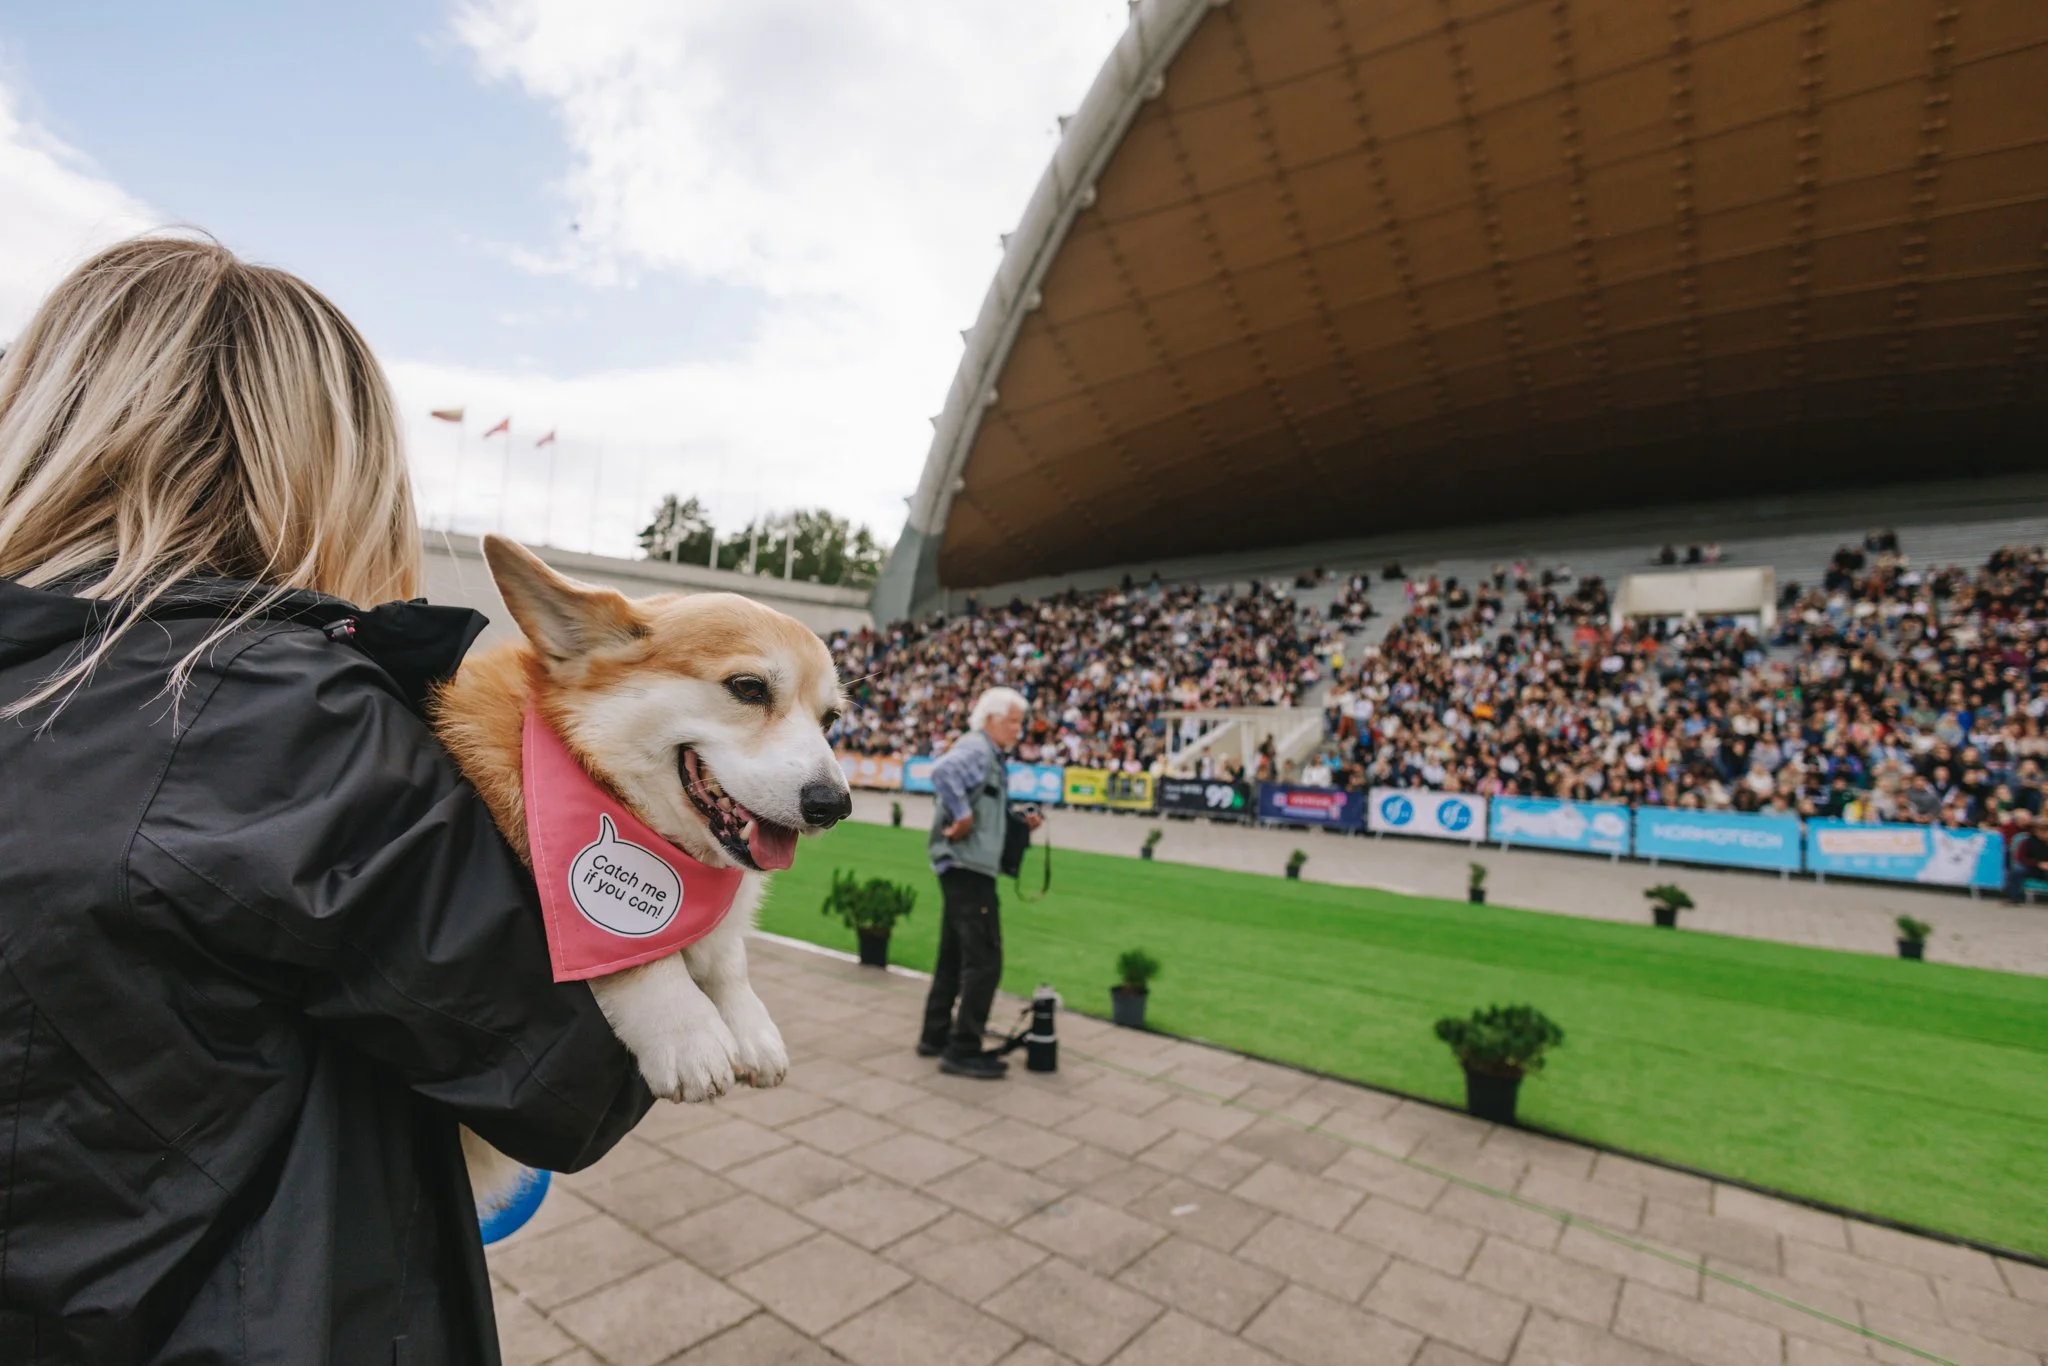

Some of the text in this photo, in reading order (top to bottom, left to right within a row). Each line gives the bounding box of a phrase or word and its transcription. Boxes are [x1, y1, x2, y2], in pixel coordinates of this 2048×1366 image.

[583, 869, 663, 919] if you can!
[593, 855, 666, 902] Catch me
